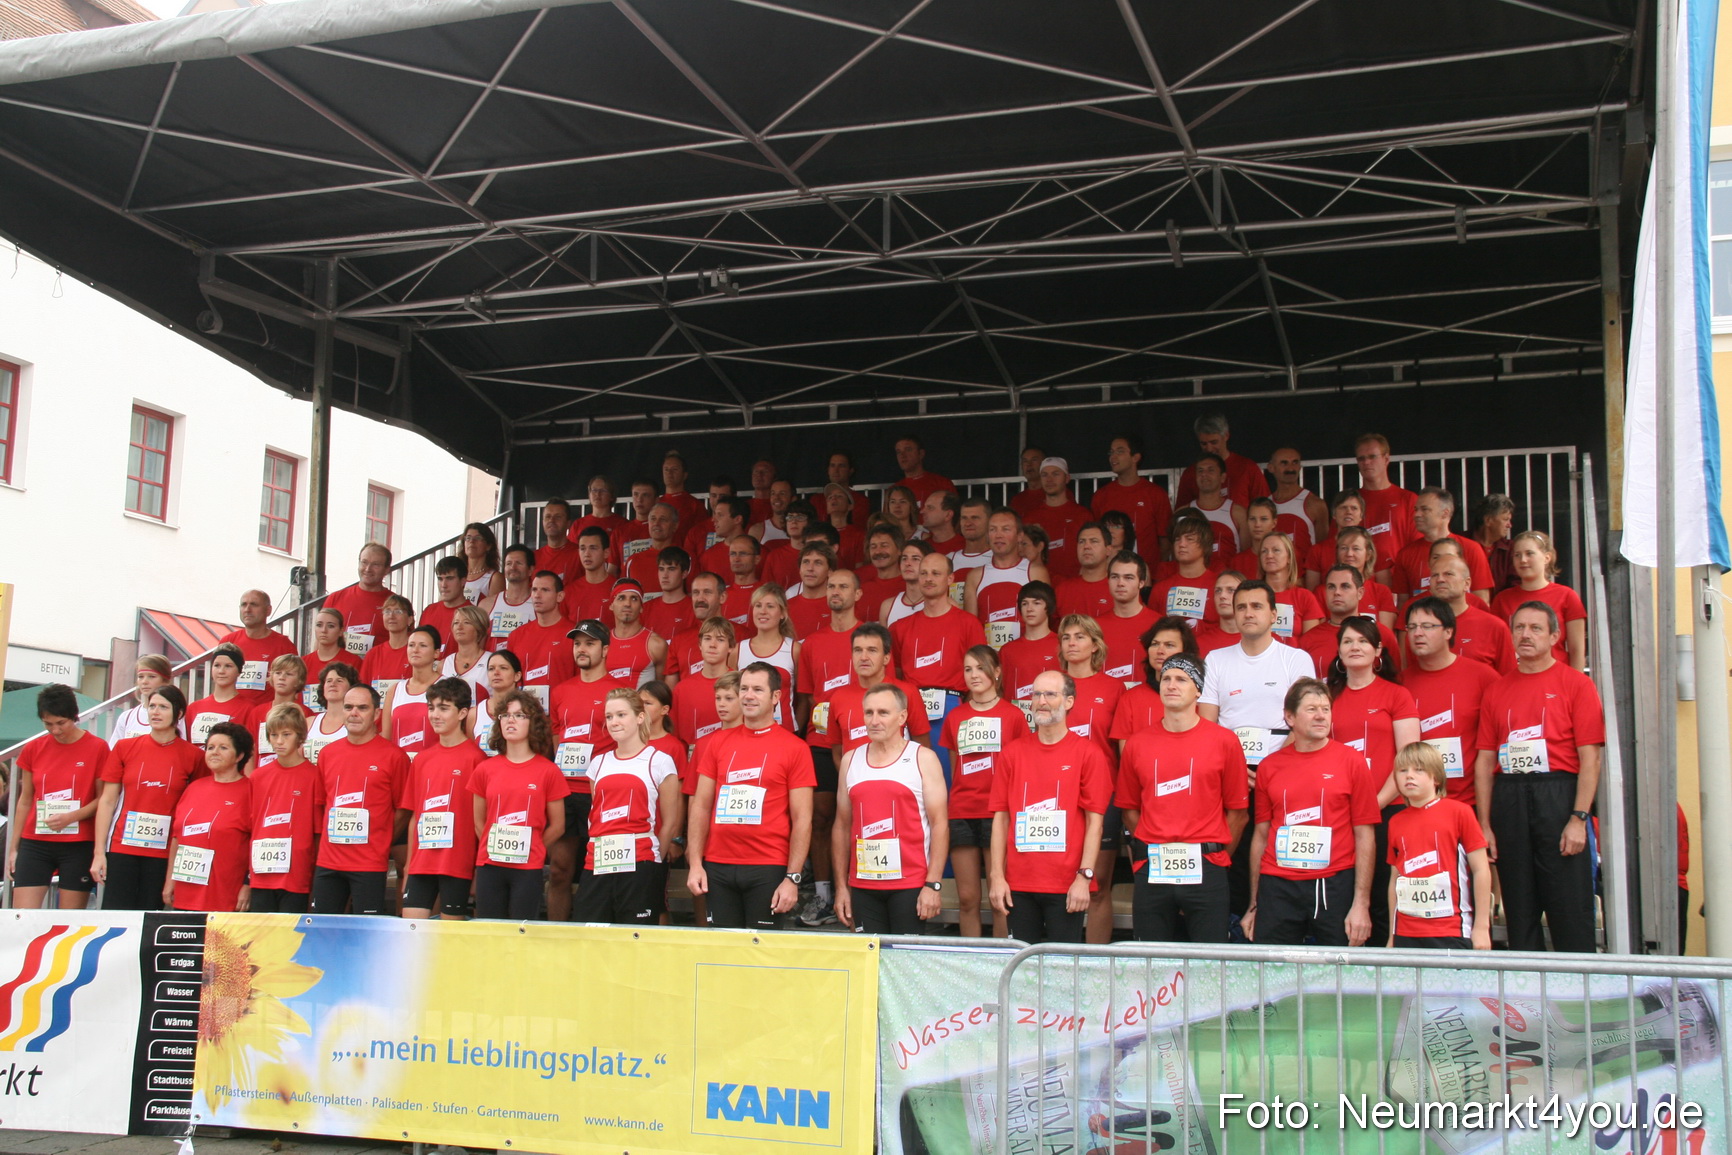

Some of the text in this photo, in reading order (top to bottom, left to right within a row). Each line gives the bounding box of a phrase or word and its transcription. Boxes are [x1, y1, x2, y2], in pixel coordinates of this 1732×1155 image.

[1177, 588, 1195, 596] Florian
[1176, 598, 1201, 608] 2555
[995, 633, 1014, 643] 315
[347, 642, 369, 652] 5081
[40, 663, 71, 676] BETTEN
[243, 663, 256, 671] gbert
[240, 671, 263, 680] 2575
[201, 715, 219, 723] Kathrin
[968, 720, 985, 728] Sarah
[968, 730, 997, 741] 5080
[564, 755, 586, 765] 2519
[1511, 755, 1542, 768] 2524
[731, 788, 748, 796] Oliver
[47, 803, 71, 811] Susanne
[730, 799, 757, 810] 2518
[138, 816, 158, 824] Andrea
[424, 815, 442, 823] Michael
[1029, 814, 1050, 822] Walter
[136, 824, 164, 837] 2534
[337, 821, 363, 831] 2576
[425, 825, 448, 836] 2577
[497, 828, 520, 836] Melanie
[1029, 826, 1060, 837] 2569
[1291, 829, 1310, 838] Franz
[260, 840, 288, 848] Alexander
[497, 839, 526, 851] 5091
[602, 838, 616, 847] Julia
[864, 843, 881, 851] Josef
[1291, 841, 1324, 854] 2587
[183, 848, 203, 859] Christa
[603, 848, 631, 861] 5087
[1162, 846, 1187, 855] Thomas
[260, 851, 287, 862] 4043
[873, 854, 889, 867] 14
[181, 860, 207, 873] 5071
[1164, 858, 1196, 870] 2585
[1409, 878, 1429, 886] Lukas
[1411, 888, 1447, 904] 4044
[171, 930, 197, 939] Strom
[170, 958, 195, 968] Erdgas
[166, 987, 195, 996] Wasser
[164, 1017, 194, 1026] Wärme
[890, 970, 1187, 1071] Wasser zum Leben
[162, 1046, 194, 1056] Freizeit
[1157, 1041, 1174, 1060] Die
[214, 1084, 664, 1132] Pflastersteine Außenplatten Palisaden Stufen Gartenmauern www.kann.de
[706, 1081, 831, 1130] KANN
